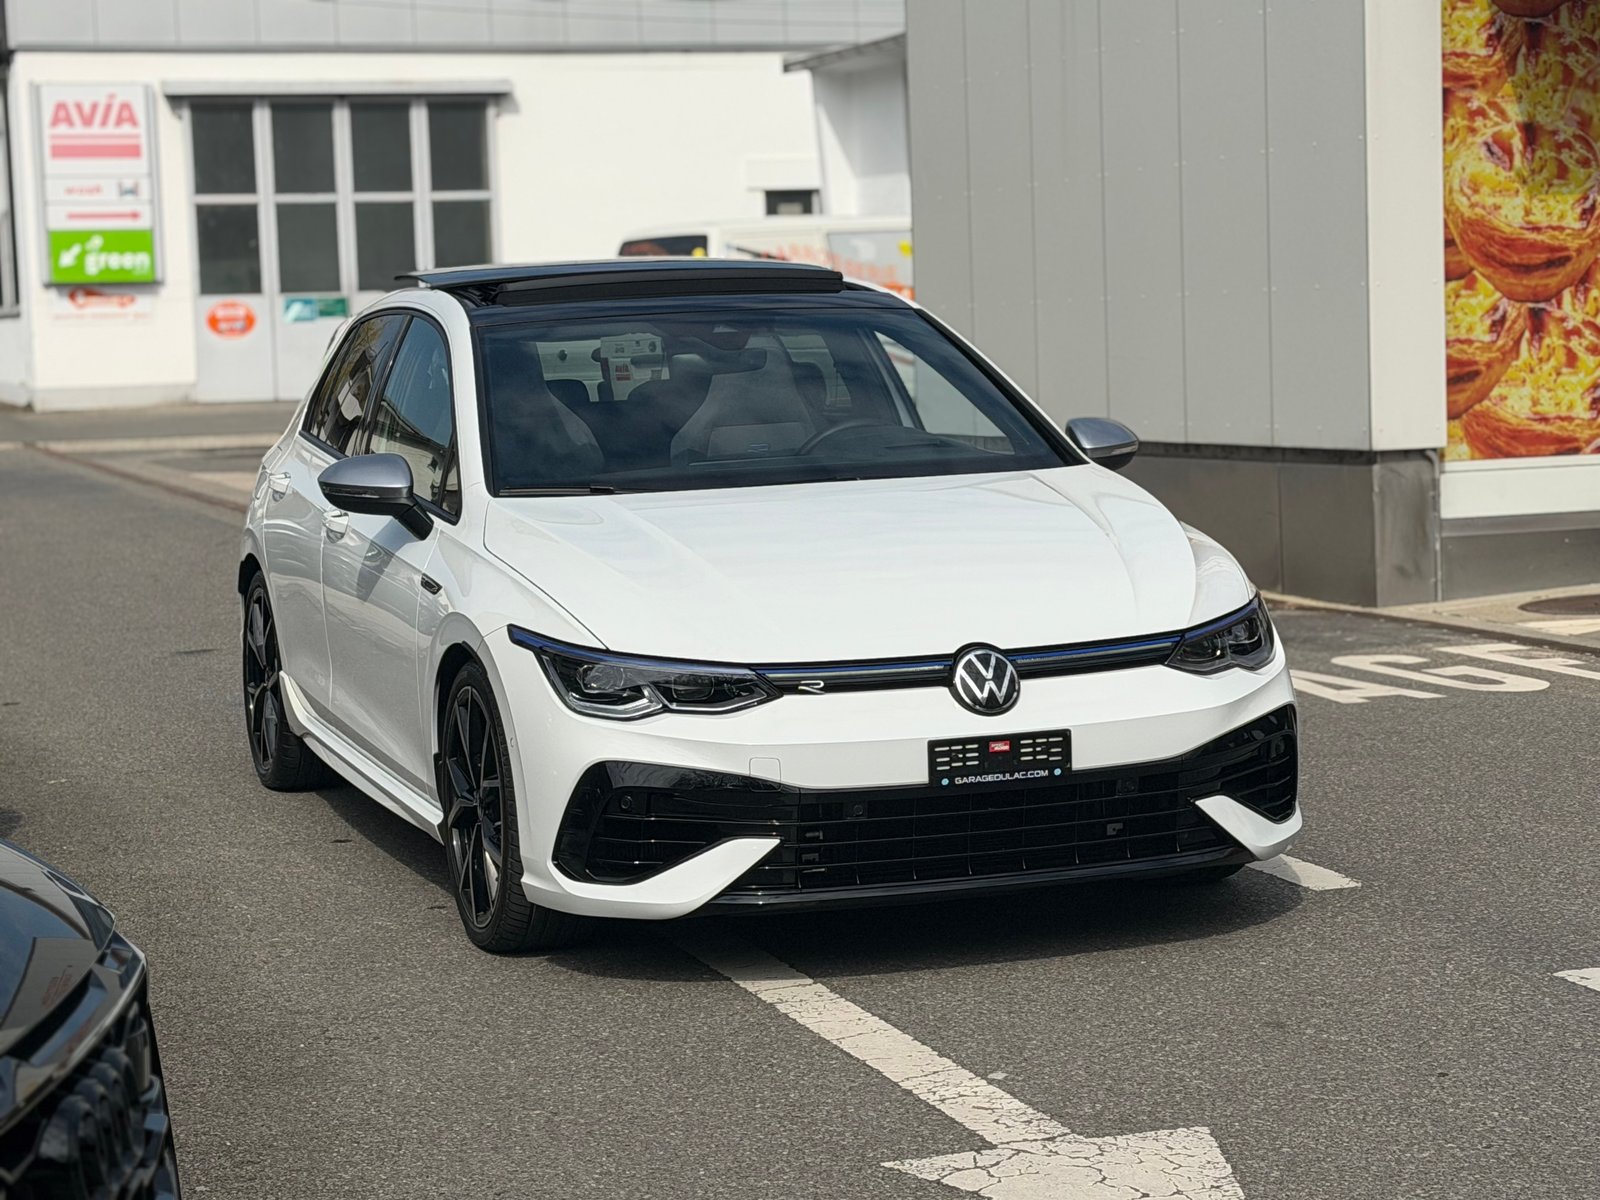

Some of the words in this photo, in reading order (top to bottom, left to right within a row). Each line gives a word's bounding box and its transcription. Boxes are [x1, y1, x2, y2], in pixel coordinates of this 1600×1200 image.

[85, 251, 151, 276] green
[797, 679, 825, 695] R
[954, 769, 1049, 785] GARAGEDULAC.COM
